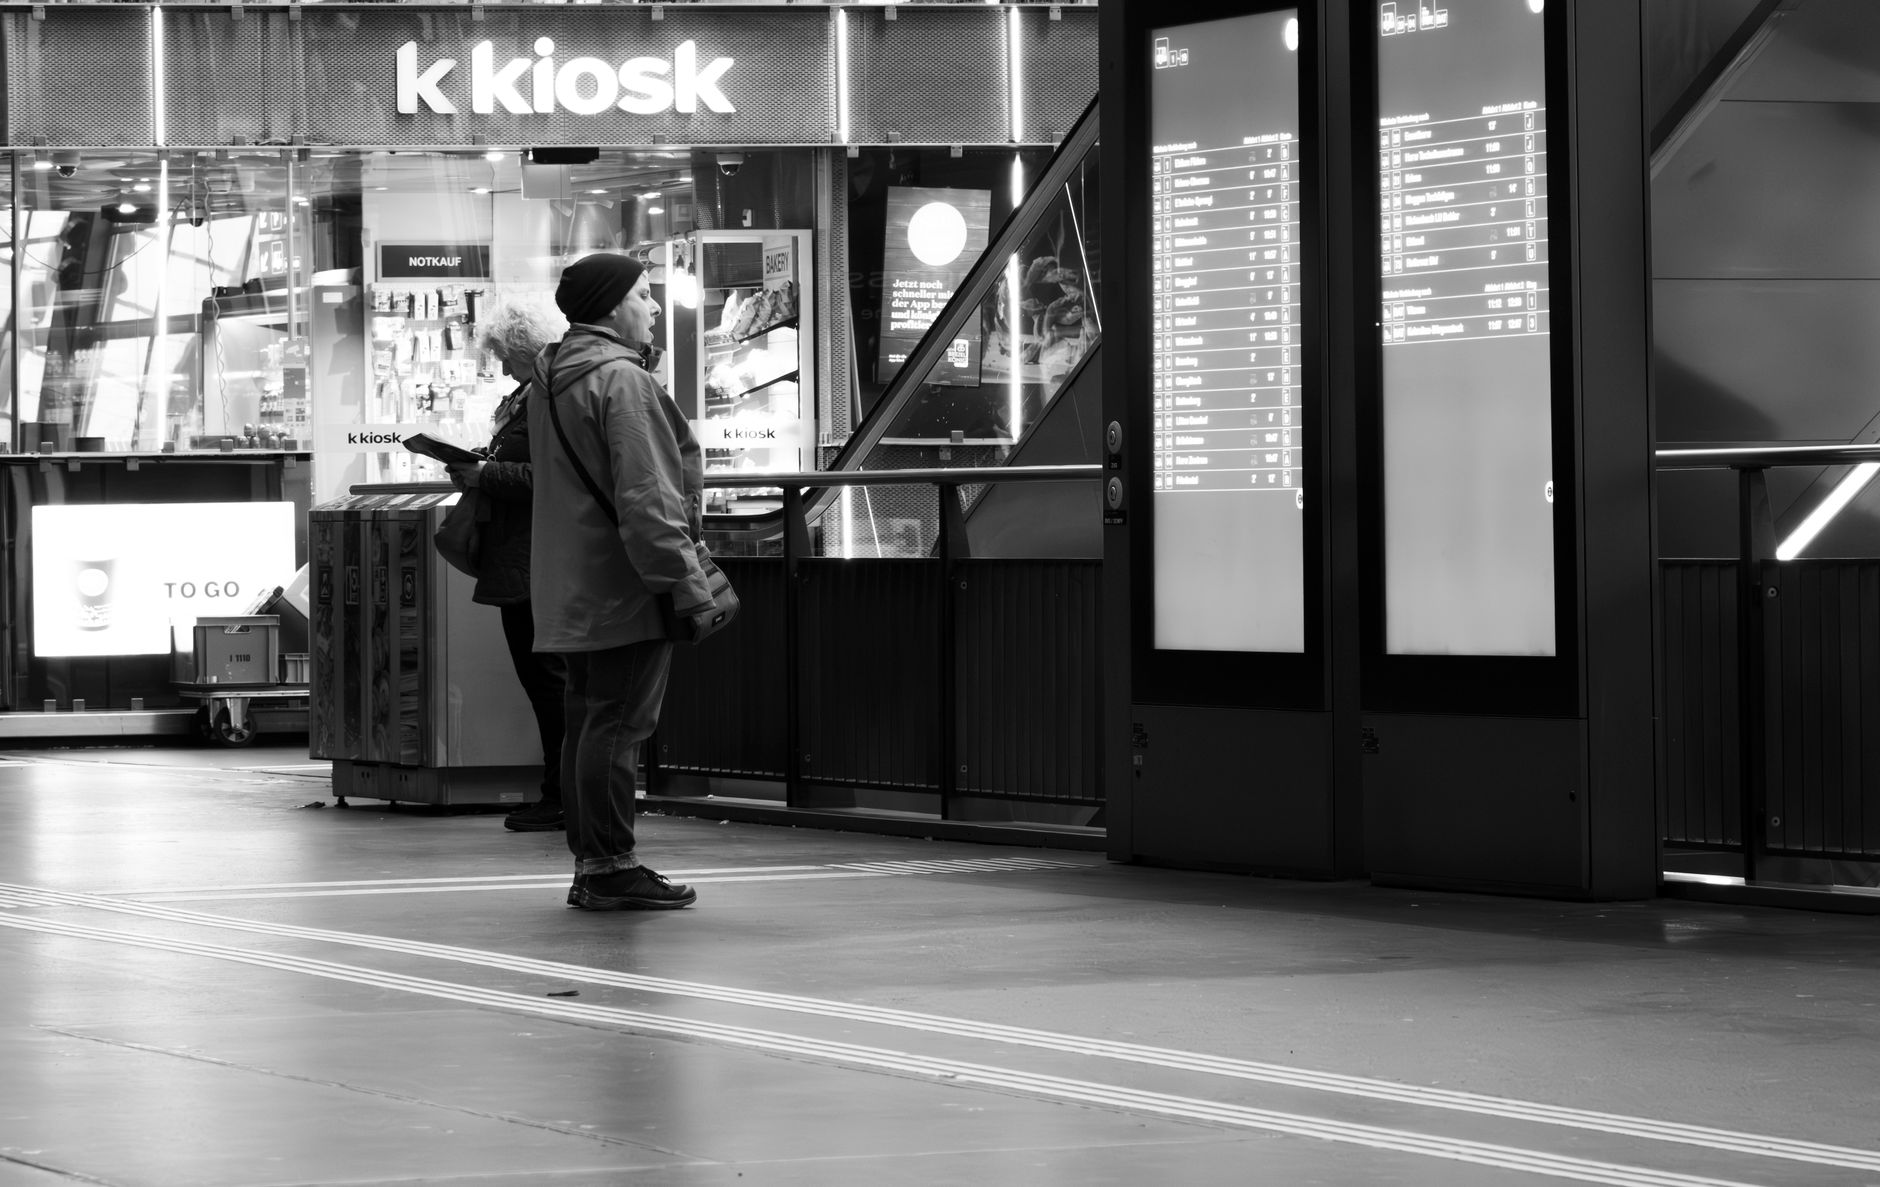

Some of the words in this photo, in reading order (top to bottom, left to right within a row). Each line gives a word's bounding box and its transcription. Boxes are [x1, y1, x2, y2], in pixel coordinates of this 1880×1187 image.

[397, 41, 458, 114] k
[470, 36, 736, 115] kiosk
[409, 256, 462, 267] NOTKAUF
[765, 252, 790, 275] BAKERY
[892, 279, 919, 289] Jetzt
[919, 279, 943, 289] noch
[892, 288, 937, 299] schneller
[891, 298, 910, 308] der
[910, 299, 931, 311] App
[891, 309, 911, 319] und
[348, 432, 358, 444] k
[359, 431, 401, 444] kiosk
[723, 428, 732, 439] k
[735, 428, 776, 439] kiosk
[163, 581, 197, 599] TO
[204, 580, 240, 598] GO
